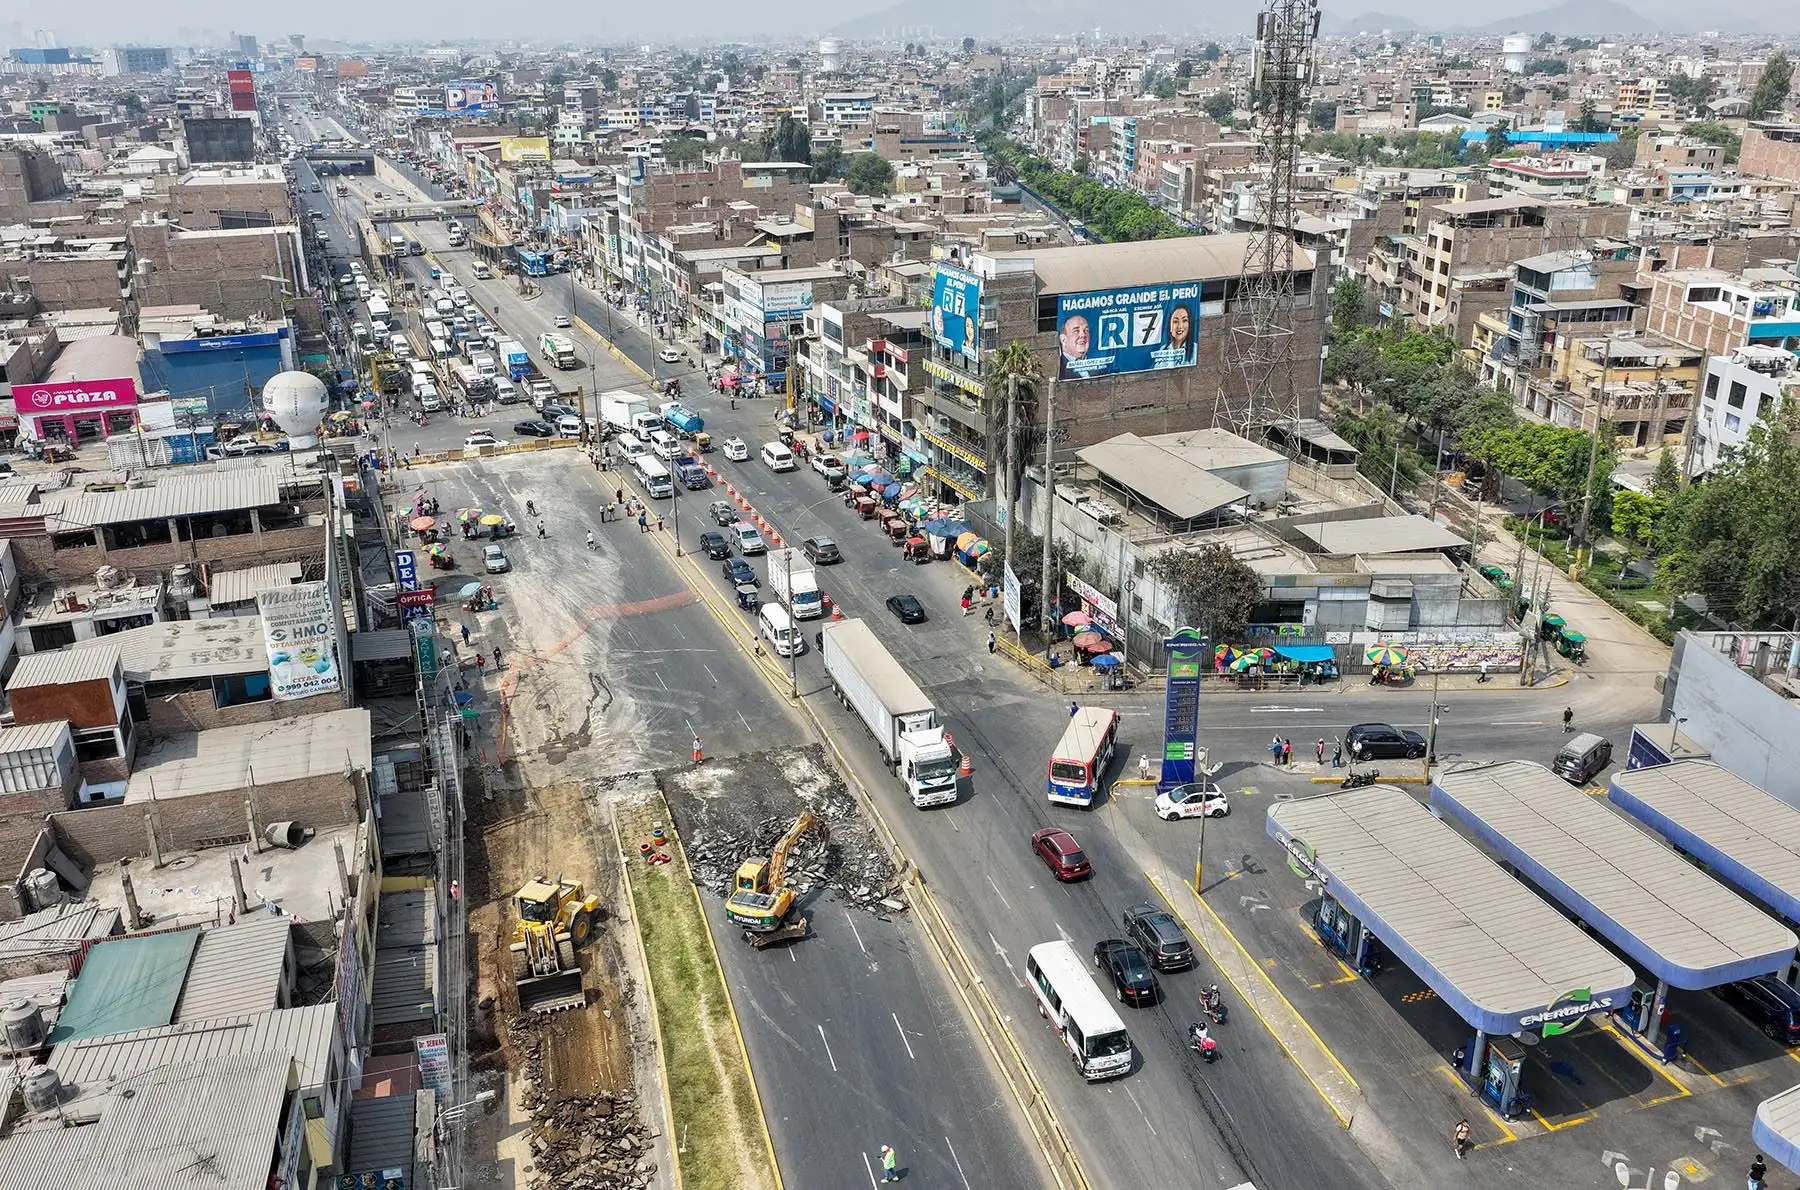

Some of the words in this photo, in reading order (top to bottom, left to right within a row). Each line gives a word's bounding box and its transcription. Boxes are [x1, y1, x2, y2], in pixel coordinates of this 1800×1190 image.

[944, 293, 952, 311] R
[957, 297, 963, 314] 7
[1062, 296, 1113, 311] HAGAMOS
[1115, 291, 1157, 305] GRANDE
[1159, 290, 1171, 300] EL
[1172, 284, 1199, 299] PERÚ
[1101, 316, 1125, 349] R
[1139, 312, 1158, 345] 7
[54, 390, 117, 405] PLAZA
[261, 588, 321, 606] Medina
[293, 623, 328, 639] HMO
[286, 682, 301, 691] 999
[303, 679, 320, 688] 042
[733, 915, 761, 925] HYUNDAI
[1519, 997, 1613, 1026] ENERGIGAS
